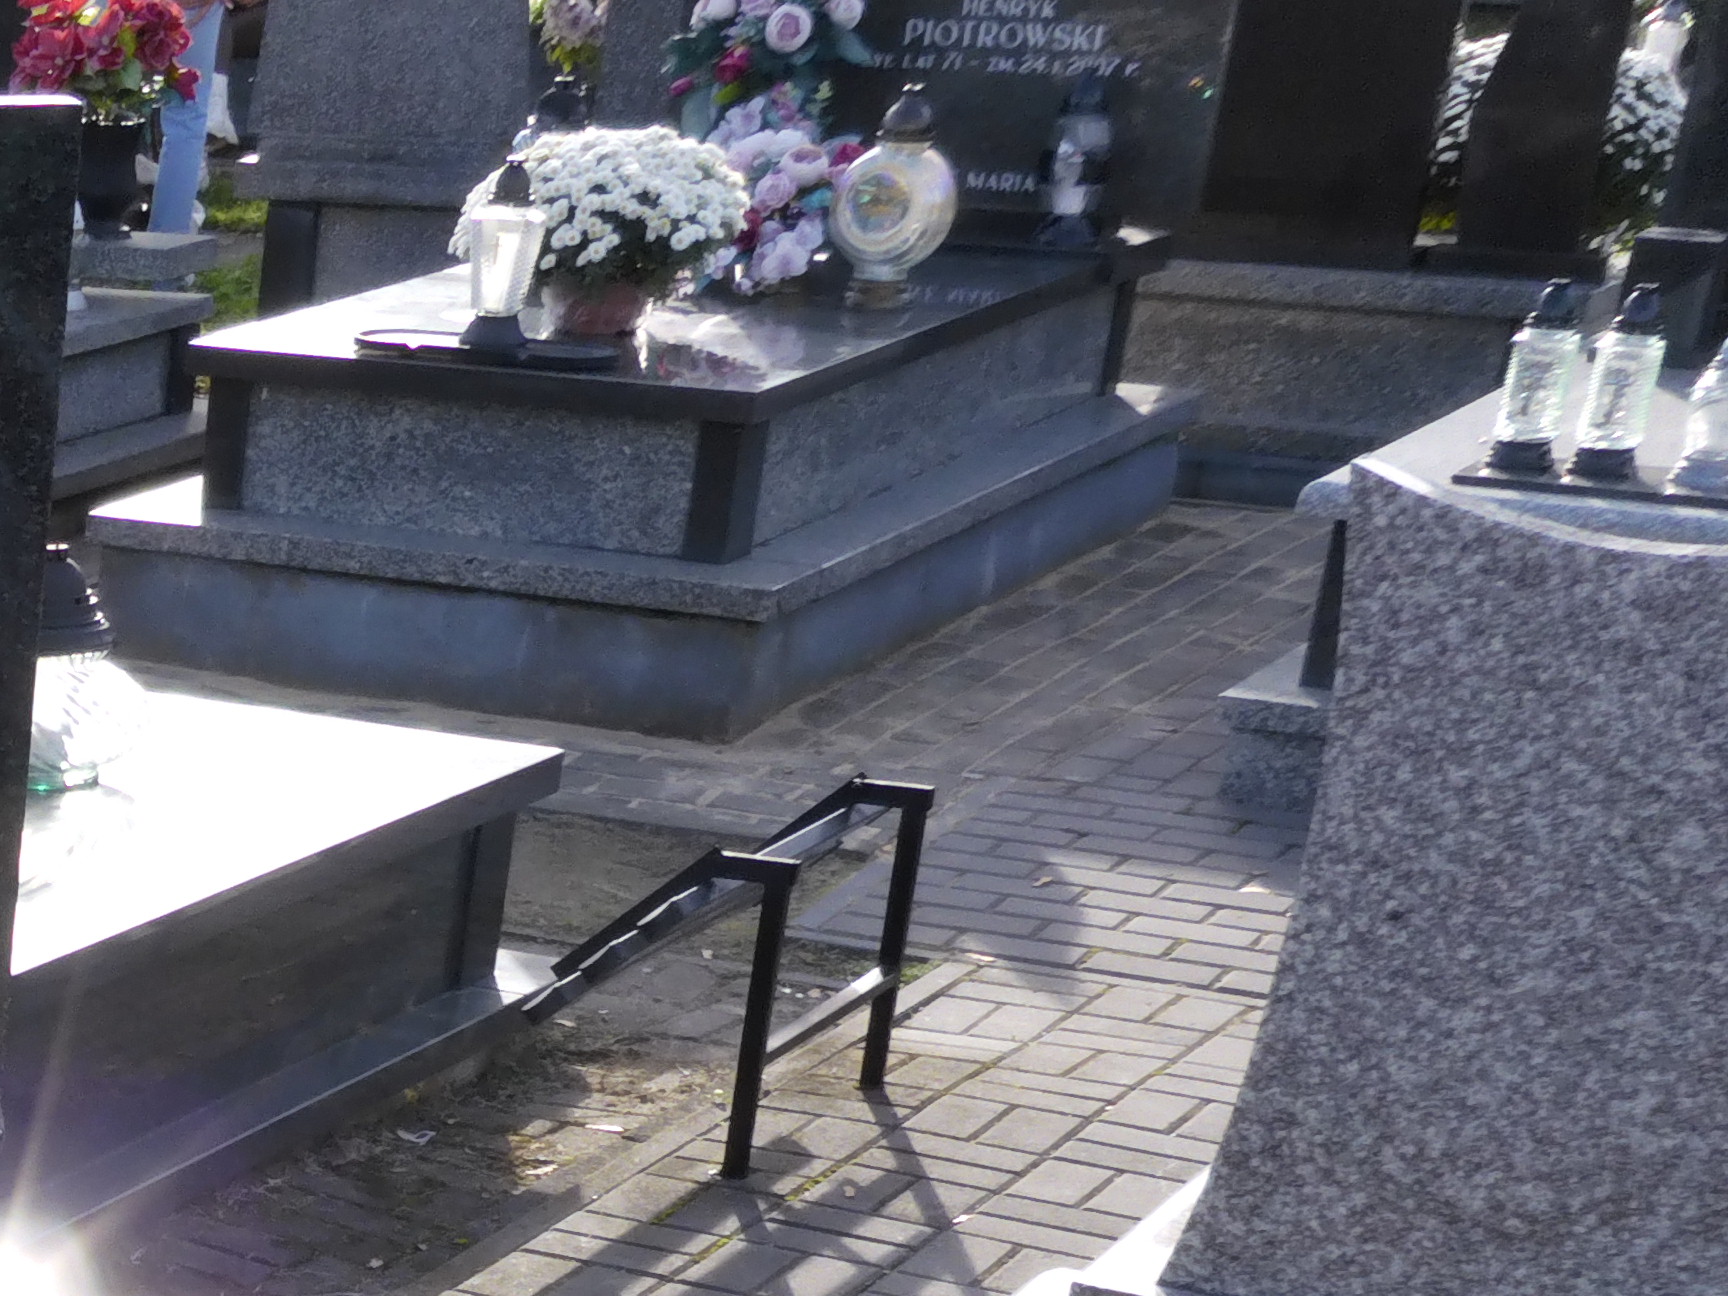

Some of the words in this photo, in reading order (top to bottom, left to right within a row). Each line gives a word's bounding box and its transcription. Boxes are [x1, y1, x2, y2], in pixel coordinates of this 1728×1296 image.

[960, 0, 1058, 19] HENRYK
[902, 17, 1107, 51] PIOTROWSKI
[966, 171, 1036, 193] MARIA
